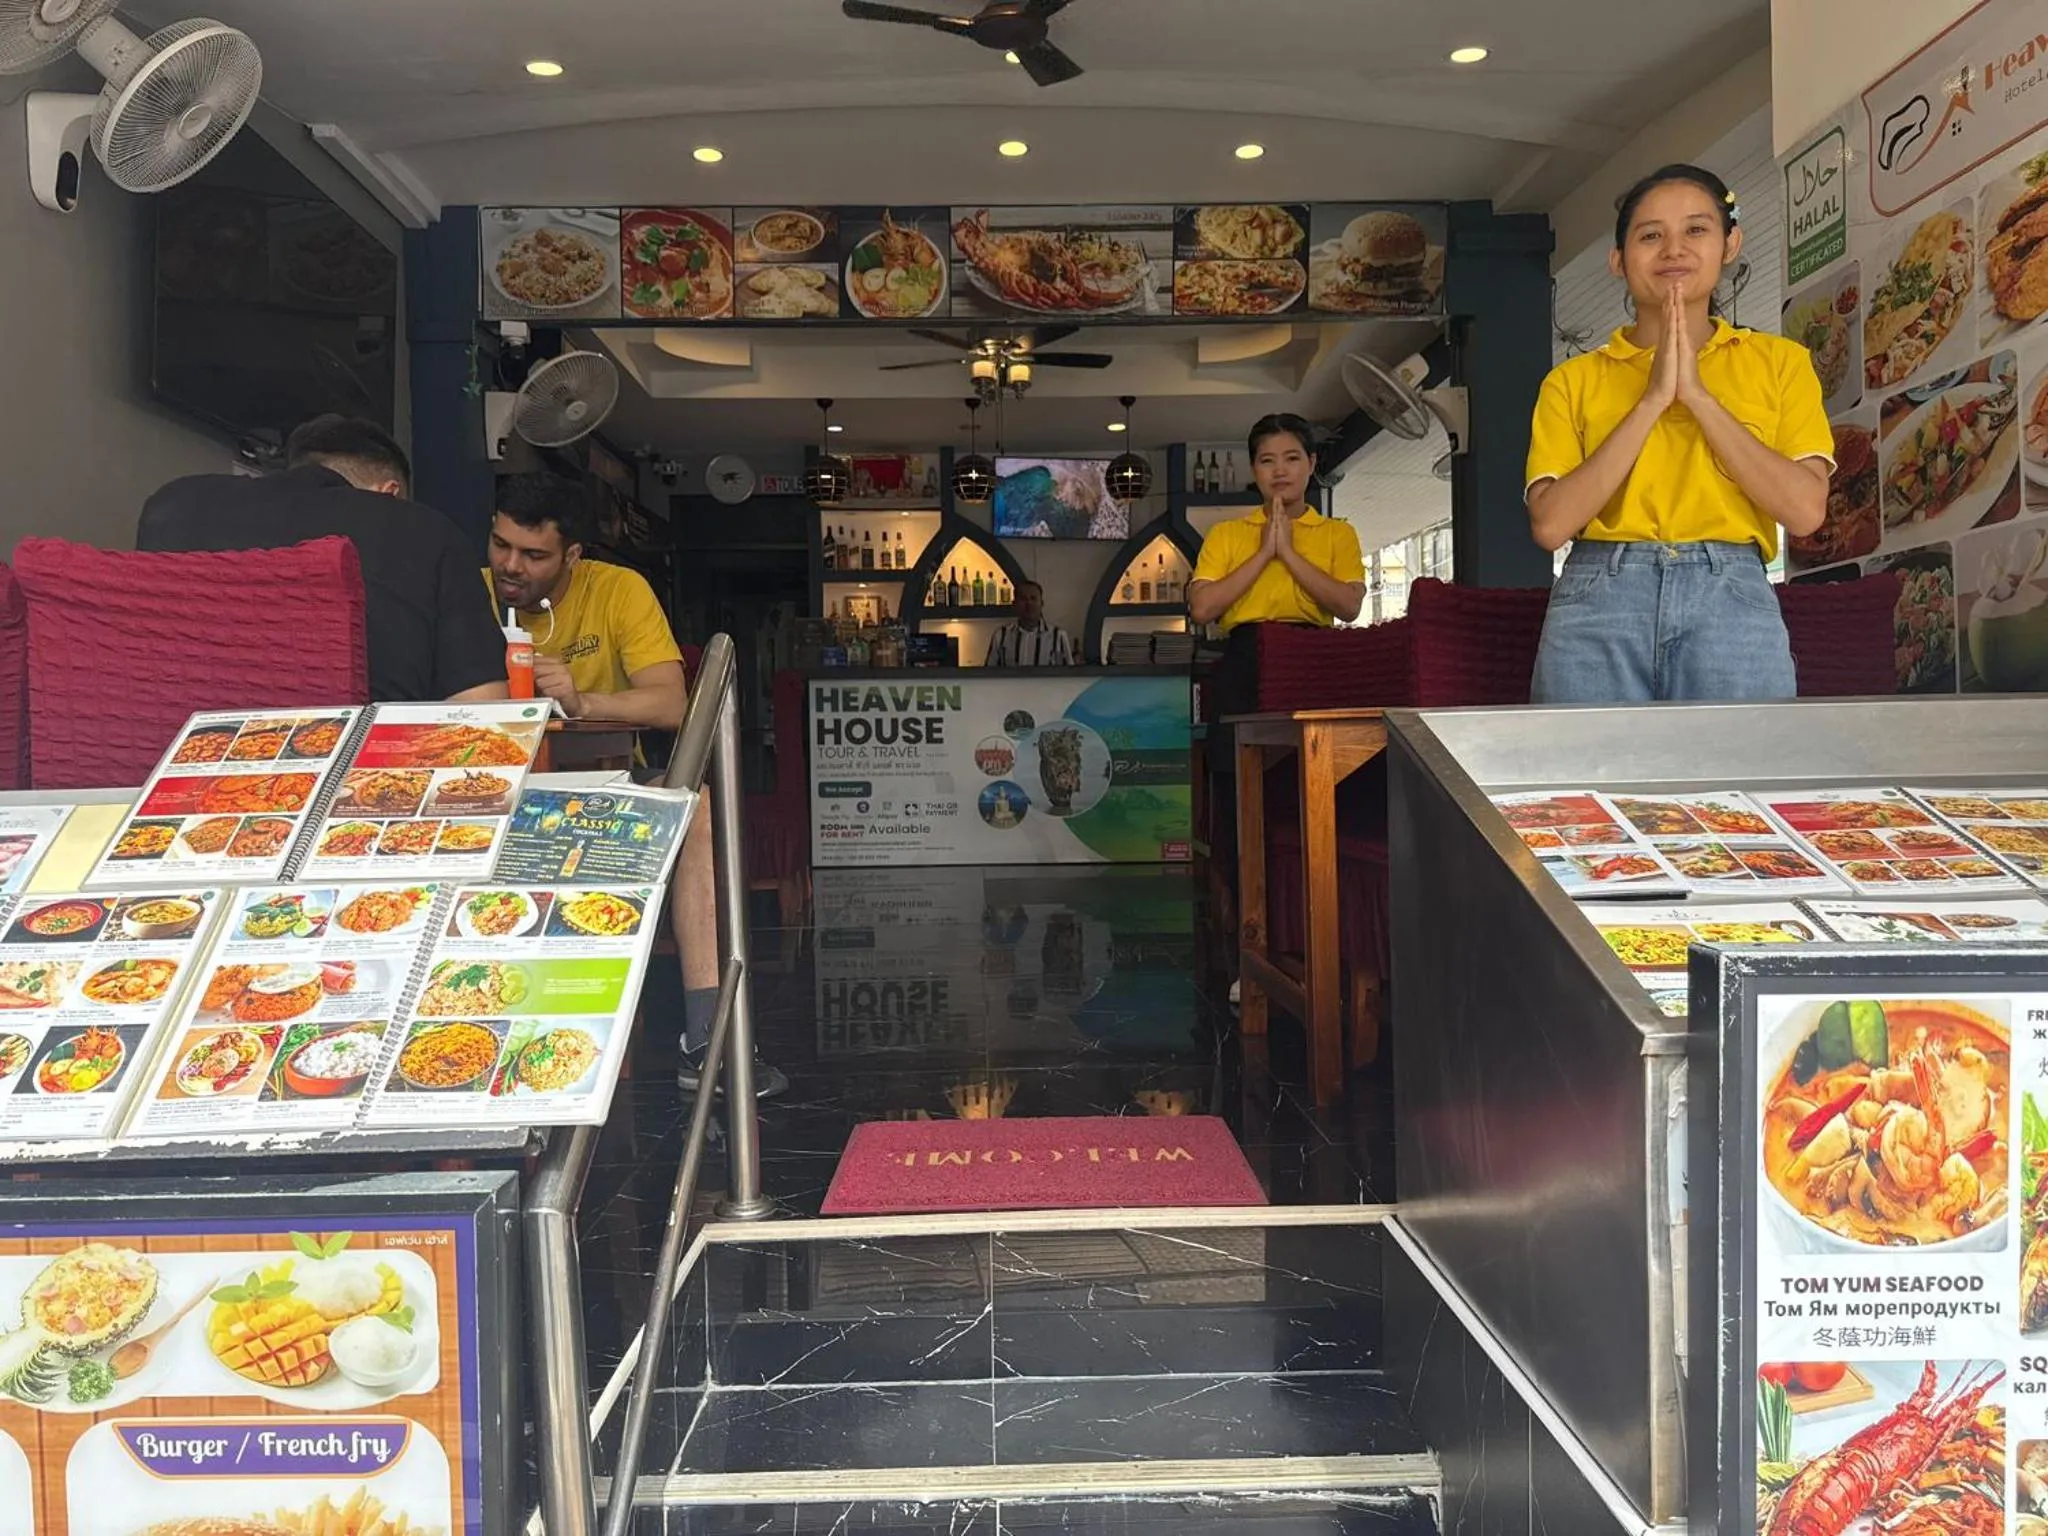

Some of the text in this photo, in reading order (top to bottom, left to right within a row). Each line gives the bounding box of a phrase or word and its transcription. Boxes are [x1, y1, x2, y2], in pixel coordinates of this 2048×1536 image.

[2004, 67, 2042, 103] Hotel
[1793, 157, 1838, 207] حلال
[1793, 195, 1840, 240] HALAL
[814, 685, 962, 713] HEAVEN
[816, 716, 944, 745] HOUSE
[817, 746, 854, 760] TOUR
[858, 746, 869, 758] &
[872, 746, 921, 758] TRAVEL
[868, 822, 931, 835] Available
[1781, 1275, 1984, 1294] TOM YUM SEAFOOD
[1764, 1300, 2001, 1319] Том Ям морепродукты
[1812, 1325, 1937, 1348] 冬蔭功海鮮
[2019, 1356, 2048, 1374] SQ
[2013, 1381, 2047, 1394] кал
[136, 1432, 229, 1464] Burger
[257, 1431, 348, 1458] French
[346, 1431, 391, 1463] fry
